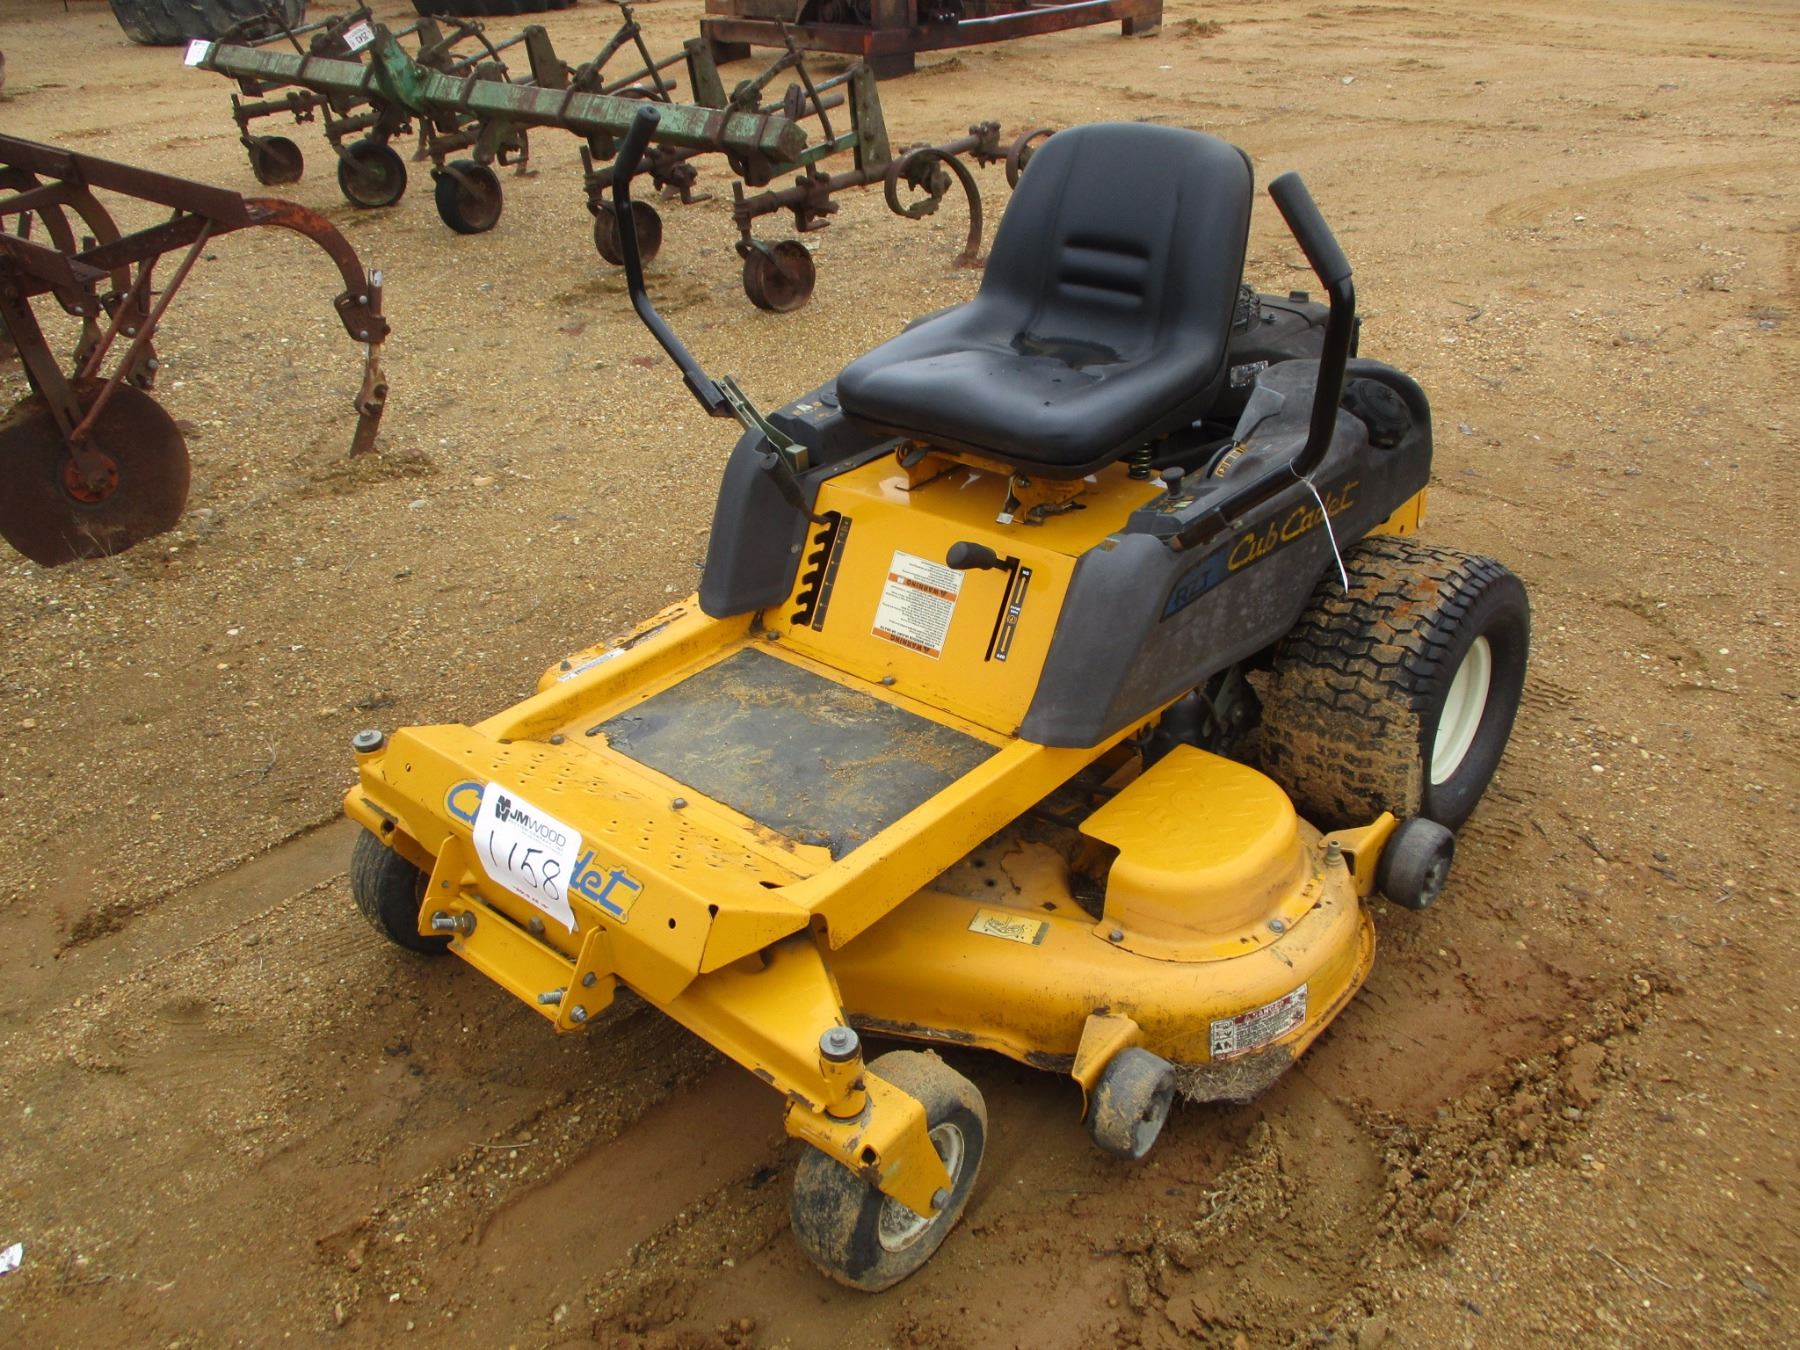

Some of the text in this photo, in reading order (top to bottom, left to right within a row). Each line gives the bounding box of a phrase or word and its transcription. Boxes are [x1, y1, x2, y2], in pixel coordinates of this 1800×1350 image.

[1227, 481, 1359, 571] Cub Cadet
[906, 578, 941, 596] WARNING
[890, 634, 922, 652] WARNING
[489, 829, 562, 901] 1158
[569, 850, 640, 915] det
